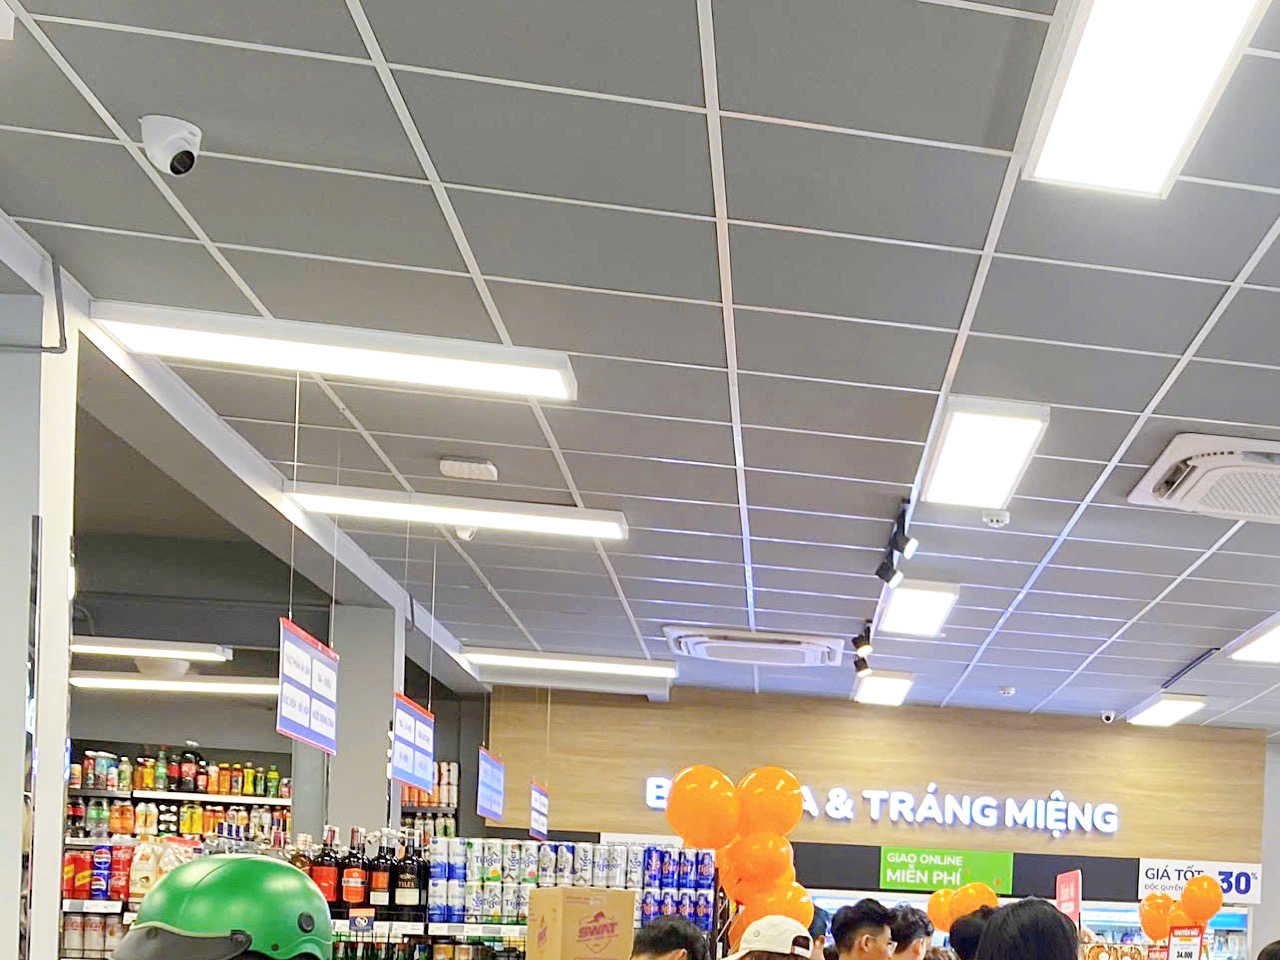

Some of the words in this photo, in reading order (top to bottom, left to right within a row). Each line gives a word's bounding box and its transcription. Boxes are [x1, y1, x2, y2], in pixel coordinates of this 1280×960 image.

[825, 788, 854, 820] &
[863, 783, 998, 828] TRÁNG
[1005, 790, 1119, 838] MIỆNG
[887, 852, 916, 865] GIAO
[919, 854, 963, 867] ONLINE
[887, 864, 930, 885] MIỄN
[932, 867, 961, 886] PHÍ
[1145, 865, 1170, 881] GIÁ
[1175, 865, 1204, 881] TỐT
[578, 922, 618, 938] SWAT
